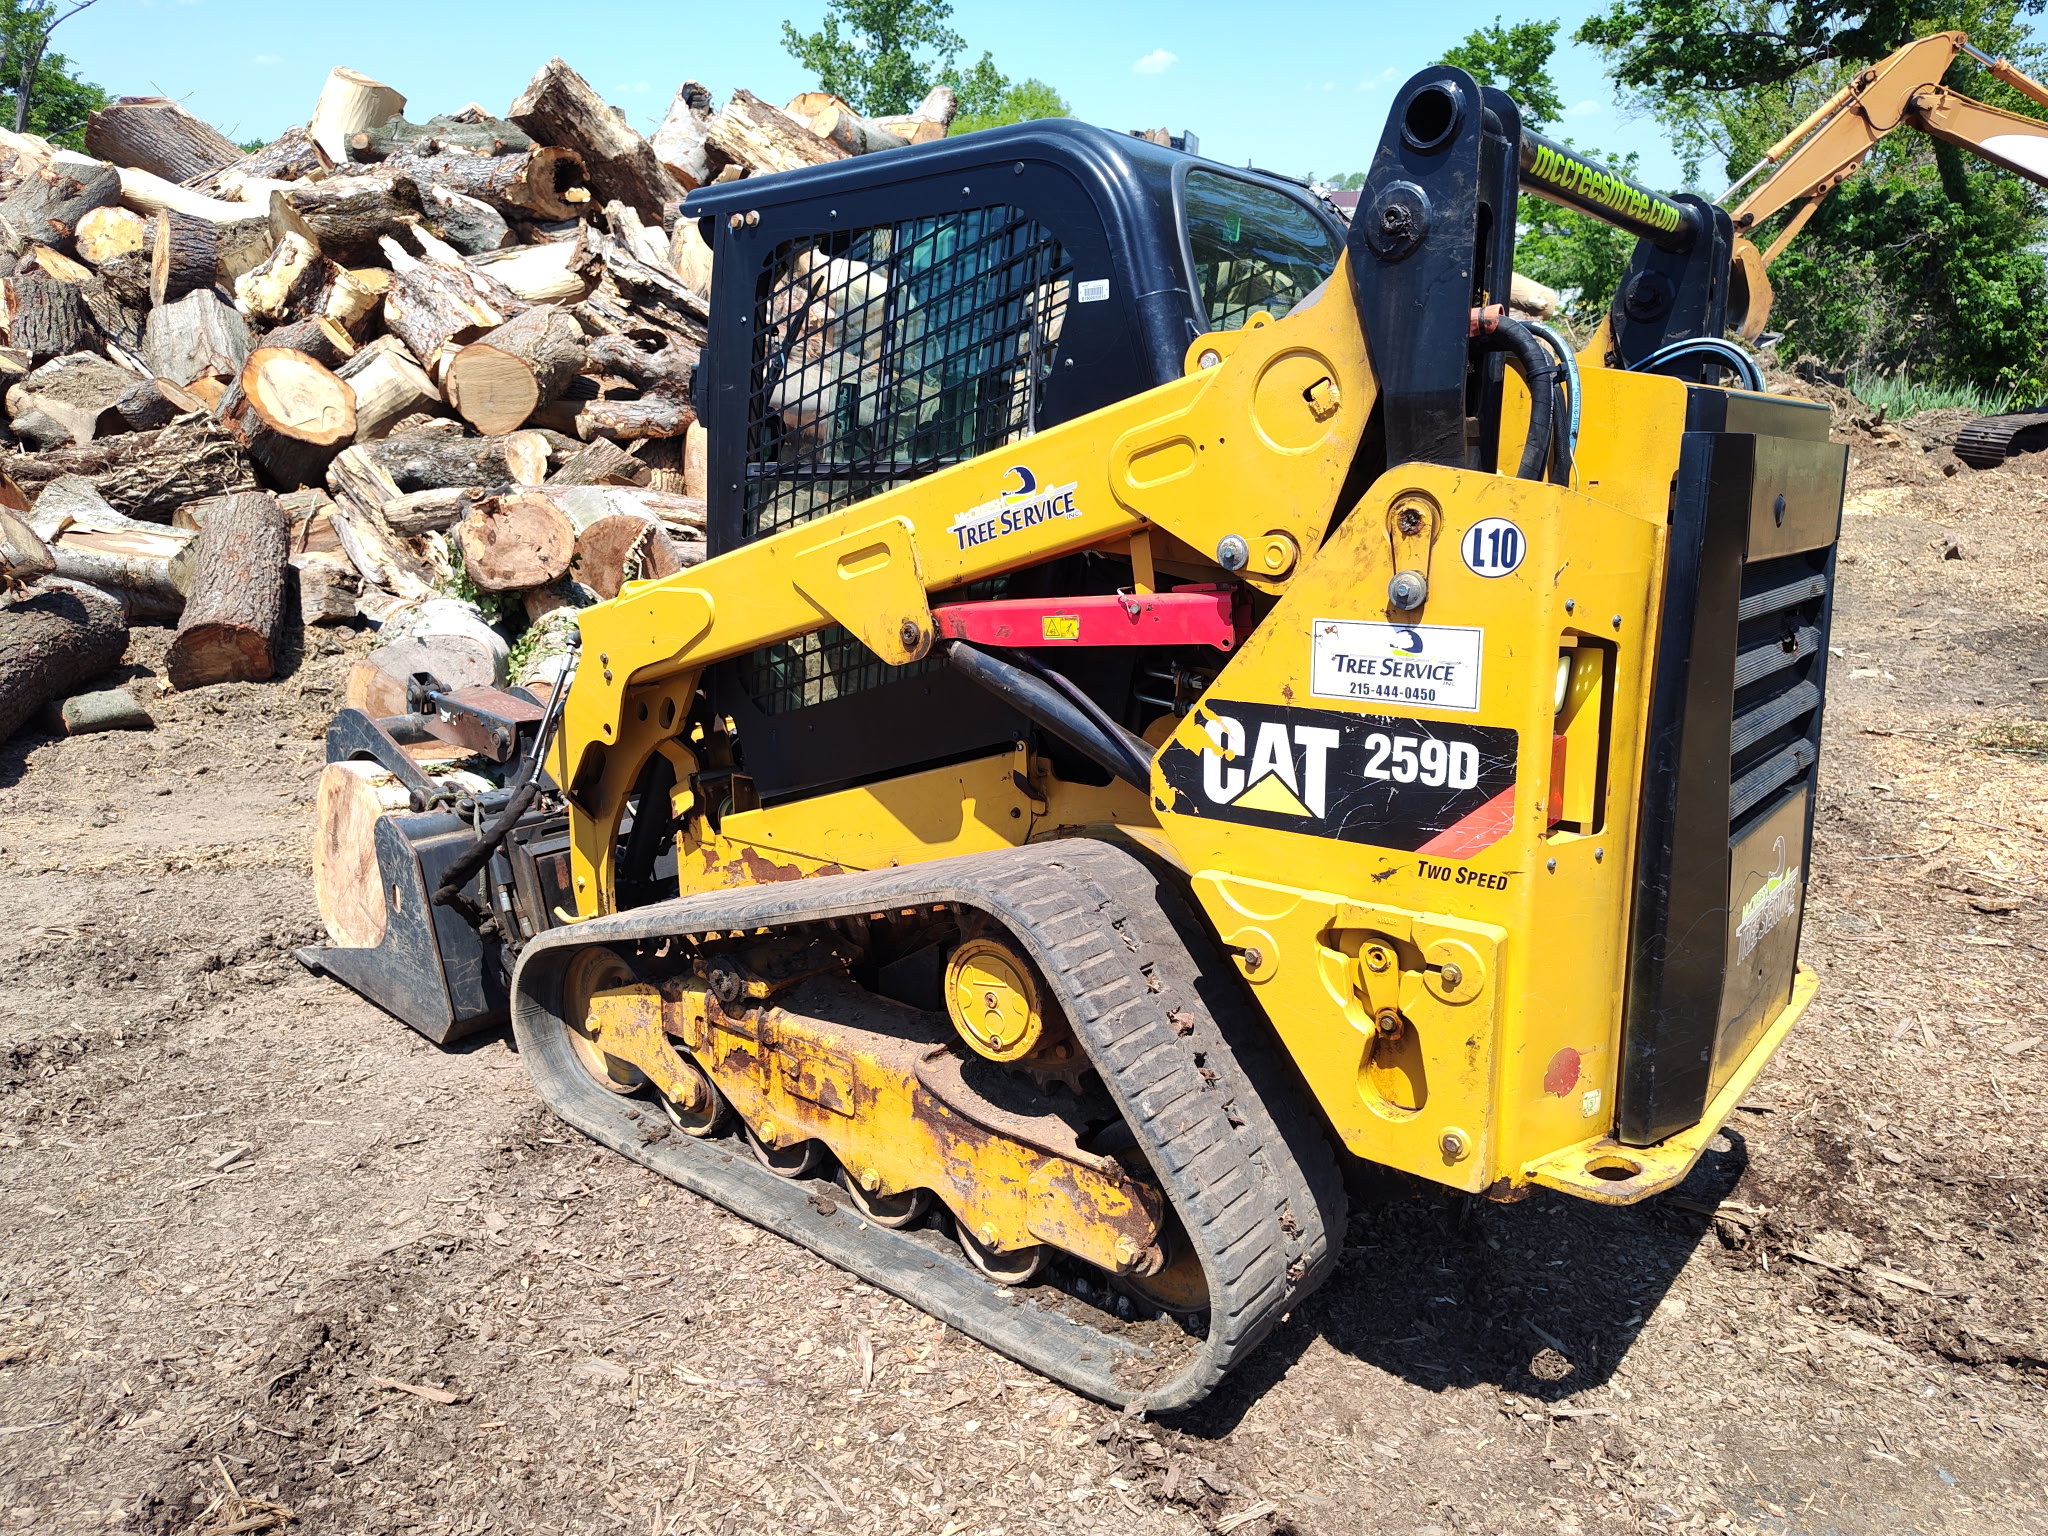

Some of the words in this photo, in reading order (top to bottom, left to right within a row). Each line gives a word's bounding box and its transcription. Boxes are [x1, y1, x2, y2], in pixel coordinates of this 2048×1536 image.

[1529, 144, 1681, 233] mccreeshtree.com
[953, 519, 998, 550] TREE
[1000, 491, 1076, 535] SERVICE
[1334, 654, 1377, 675] TREE
[1380, 658, 1455, 682] SERVICE
[1349, 681, 1436, 702] 215-444-0450
[1203, 715, 1340, 819] CAT
[1363, 733, 1480, 790] 259D
[1417, 860, 1452, 882] TWO
[1455, 866, 1508, 891] SPEED
